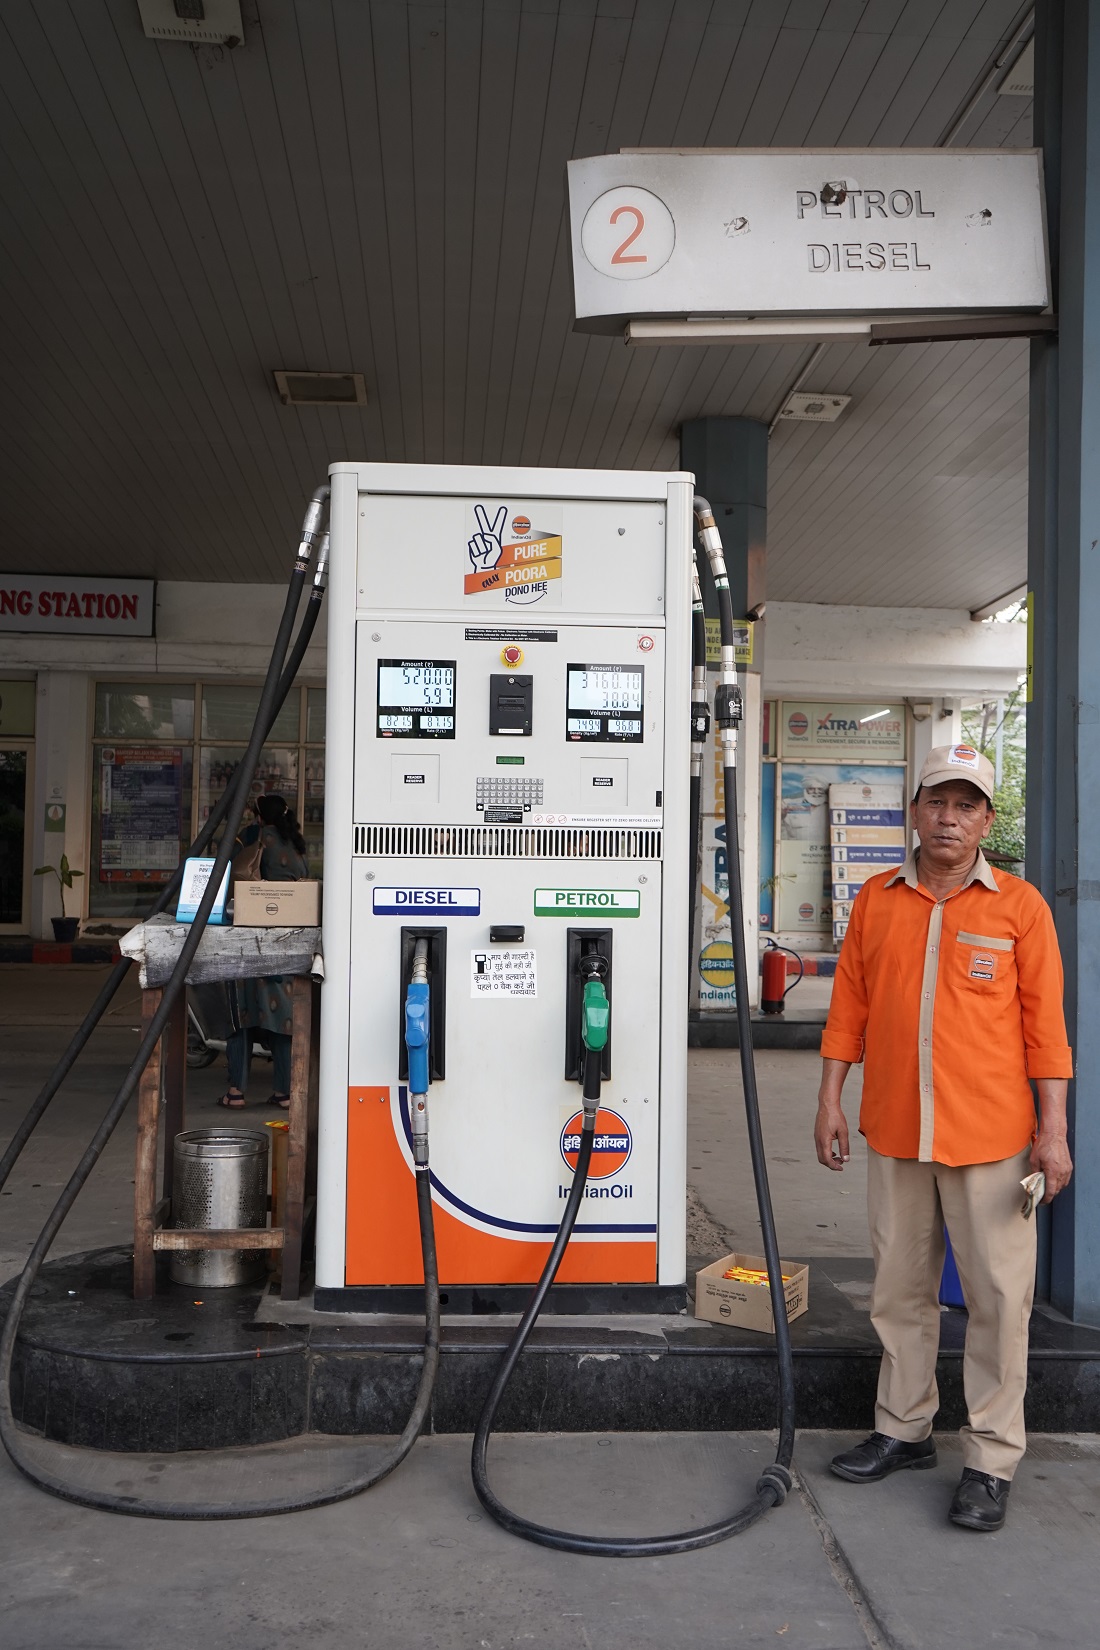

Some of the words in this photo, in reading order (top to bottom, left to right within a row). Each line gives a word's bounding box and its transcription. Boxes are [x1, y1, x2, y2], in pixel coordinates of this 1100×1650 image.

[796, 190, 935, 219] PETROL
[609, 205, 648, 265] 2
[807, 243, 931, 272] DIESEL
[514, 543, 547, 560] PURE
[505, 565, 547, 584] POORA
[505, 584, 529, 597] DONO
[531, 581, 547, 592] HEE
[38, 591, 139, 620] STATION
[403, 668, 452, 685] 520.00
[582, 672, 639, 690] 3760.10
[424, 688, 452, 704] 5.97
[428, 717, 452, 727] 87.15
[615, 720, 640, 731] 96.81
[395, 891, 457, 904] DIESEL
[555, 893, 619, 906] PETROL
[503, 952, 511, 960] की
[530, 951, 535, 961] है
[494, 961, 503, 971] सुई
[505, 961, 512, 969] की
[525, 961, 531, 969] जी
[493, 972, 503, 980] तेल
[529, 971, 535, 980] से
[477, 982, 491, 991] पहले
[526, 981, 535, 989] जी
[558, 1185, 633, 1198] InianOil
